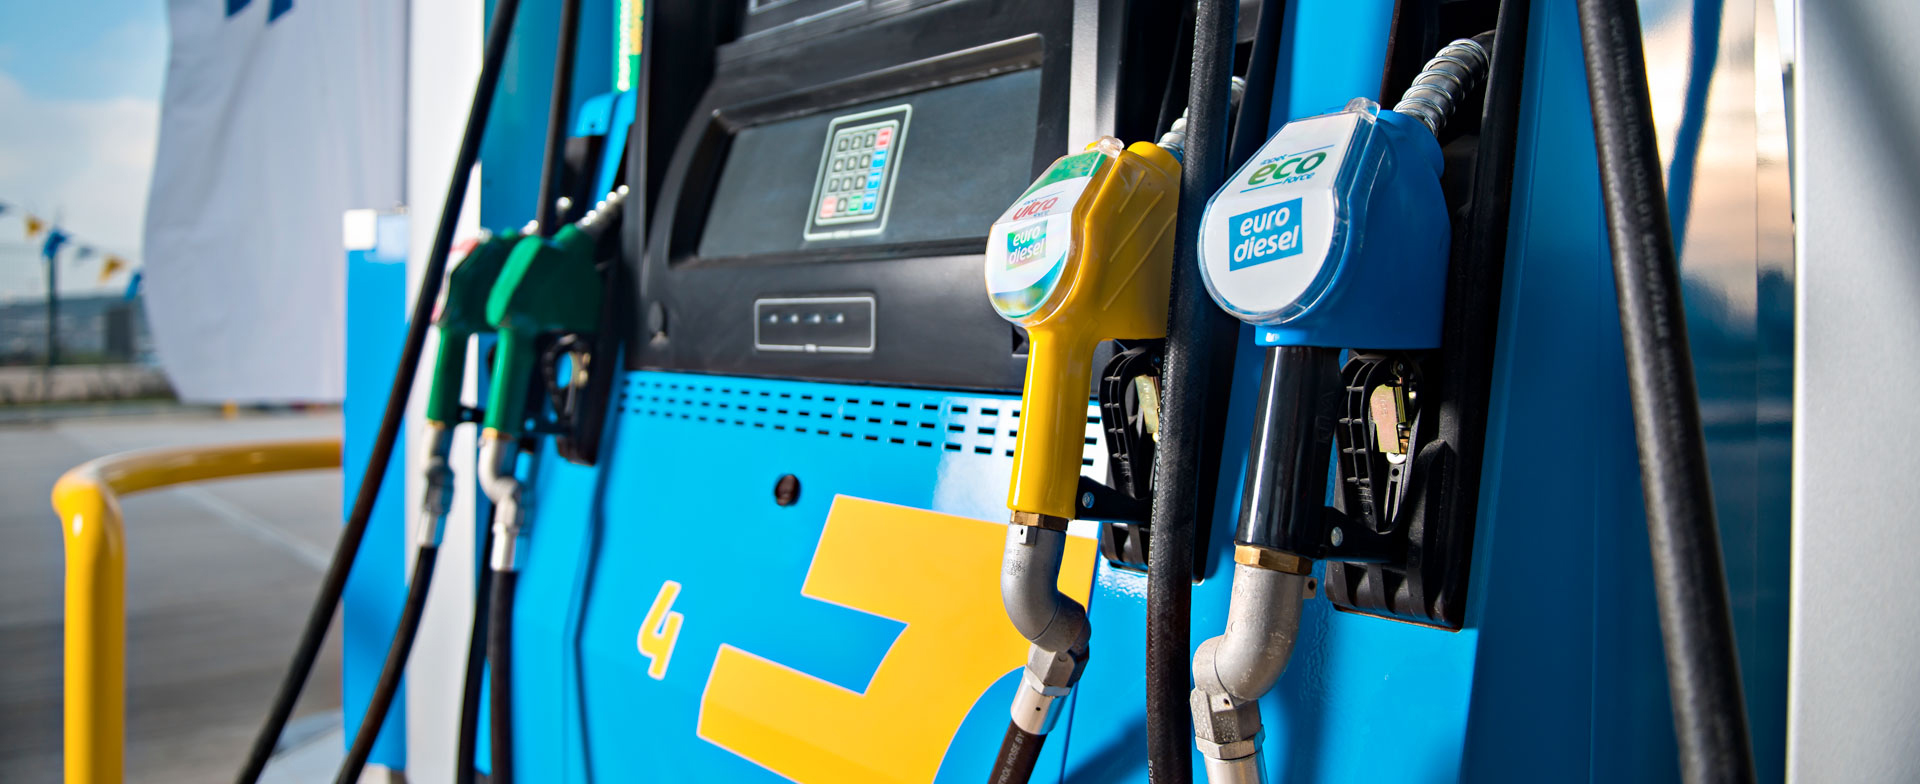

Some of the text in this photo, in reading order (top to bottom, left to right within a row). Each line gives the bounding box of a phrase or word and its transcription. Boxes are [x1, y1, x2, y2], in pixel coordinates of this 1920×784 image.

[1247, 152, 1327, 185] eco
[1013, 197, 1058, 220] ultra
[1240, 207, 1290, 236] euro
[1009, 239, 1044, 264] diesel
[1013, 226, 1040, 246] euro
[1233, 225, 1299, 262] diesel
[637, 580, 684, 680] 4
[1007, 743, 1020, 766] HOSE
[1014, 730, 1024, 744] BY
